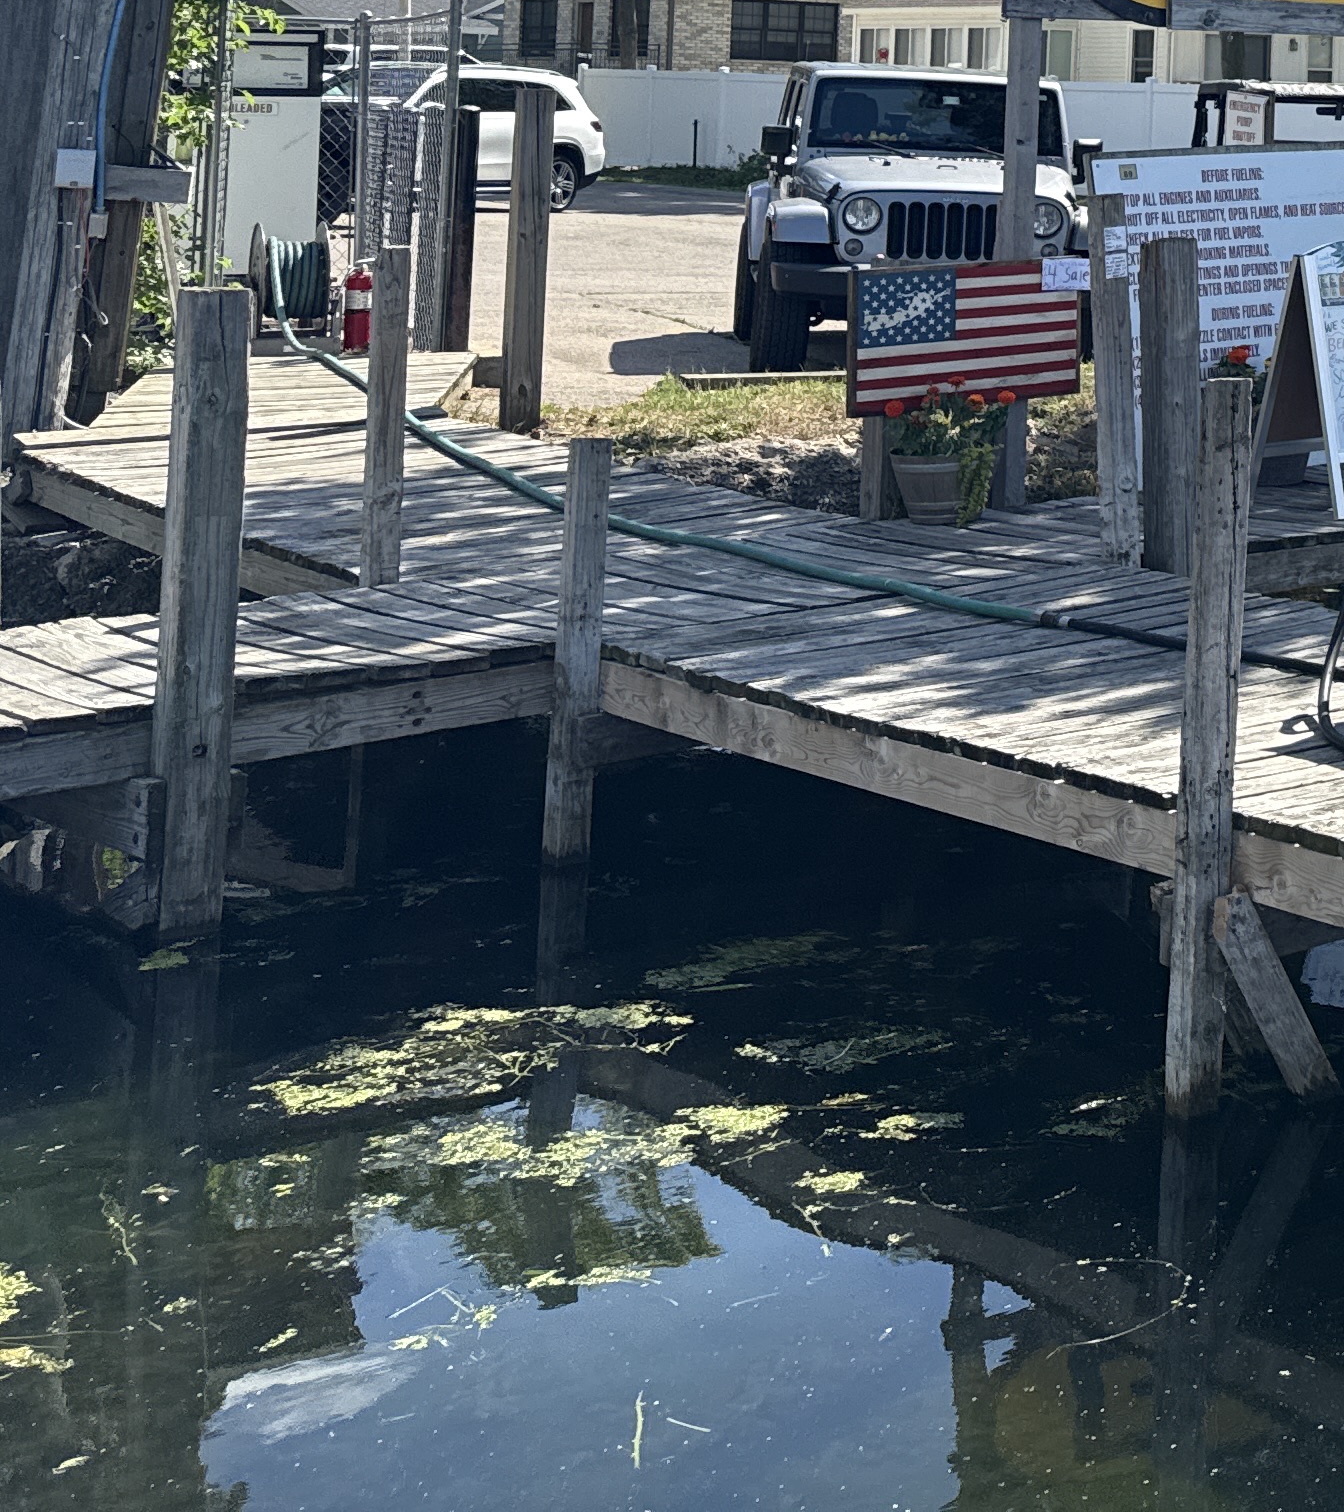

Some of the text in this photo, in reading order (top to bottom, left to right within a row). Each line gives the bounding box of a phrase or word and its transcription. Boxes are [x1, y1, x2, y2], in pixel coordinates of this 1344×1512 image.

[231, 103, 273, 114] LEADED
[1201, 169, 1230, 183] BEFORE
[1123, 193, 1140, 207] TOP
[1142, 192, 1157, 206] ALL
[1159, 190, 1193, 205] ENGINES
[1195, 189, 1212, 204] AND
[1126, 213, 1142, 226] HUT
[1144, 212, 1160, 226] OFF
[1162, 211, 1176, 225] ALL
[1177, 208, 1227, 224] ELECTRICITY,
[1228, 207, 1248, 221] OPEN
[1250, 205, 1281, 220] FLAMES,
[1283, 204, 1298, 218] AND
[1300, 203, 1317, 217] HEAT
[1197, 228, 1212, 242] FOR
[1214, 227, 1232, 241] FUEL
[1232, 225, 1264, 239] VAPORS.
[1198, 243, 1273, 261] MOKING MATERIALS.
[1062, 267, 1089, 284] Sale
[1223, 264, 1239, 278] AND
[1241, 261, 1278, 278] OPENINGS
[1198, 282, 1222, 297] ENTER
[1224, 279, 1261, 296] ENCLOSED
[1211, 305, 1240, 322] DURING
[1216, 326, 1251, 342] CONTACT
[1253, 323, 1272, 338] WITH
[1324, 320, 1338, 333] WE
